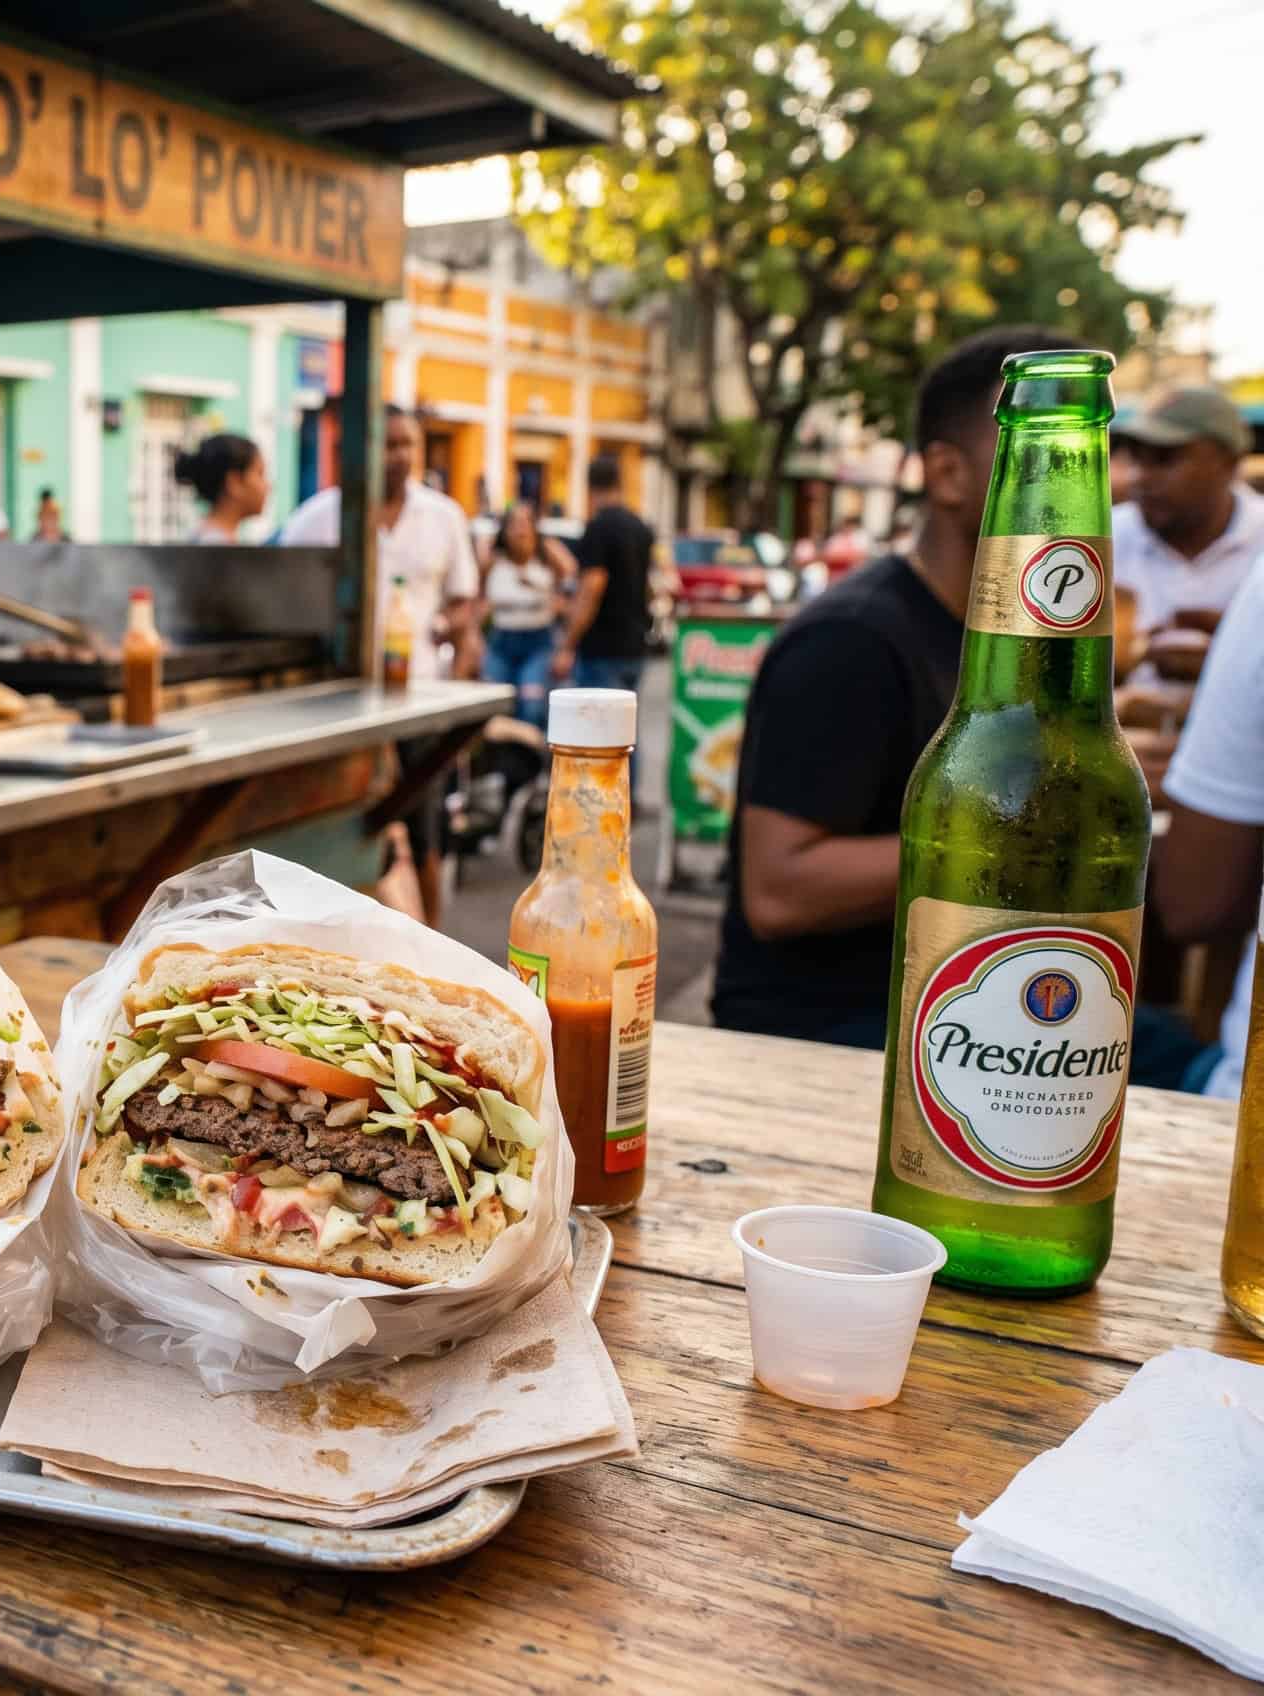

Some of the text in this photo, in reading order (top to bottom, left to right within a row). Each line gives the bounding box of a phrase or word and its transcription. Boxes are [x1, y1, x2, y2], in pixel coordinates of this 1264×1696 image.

[193, 134, 372, 270] POWER
[1044, 564, 1084, 604] P
[928, 1022, 1127, 1078] Presidente
